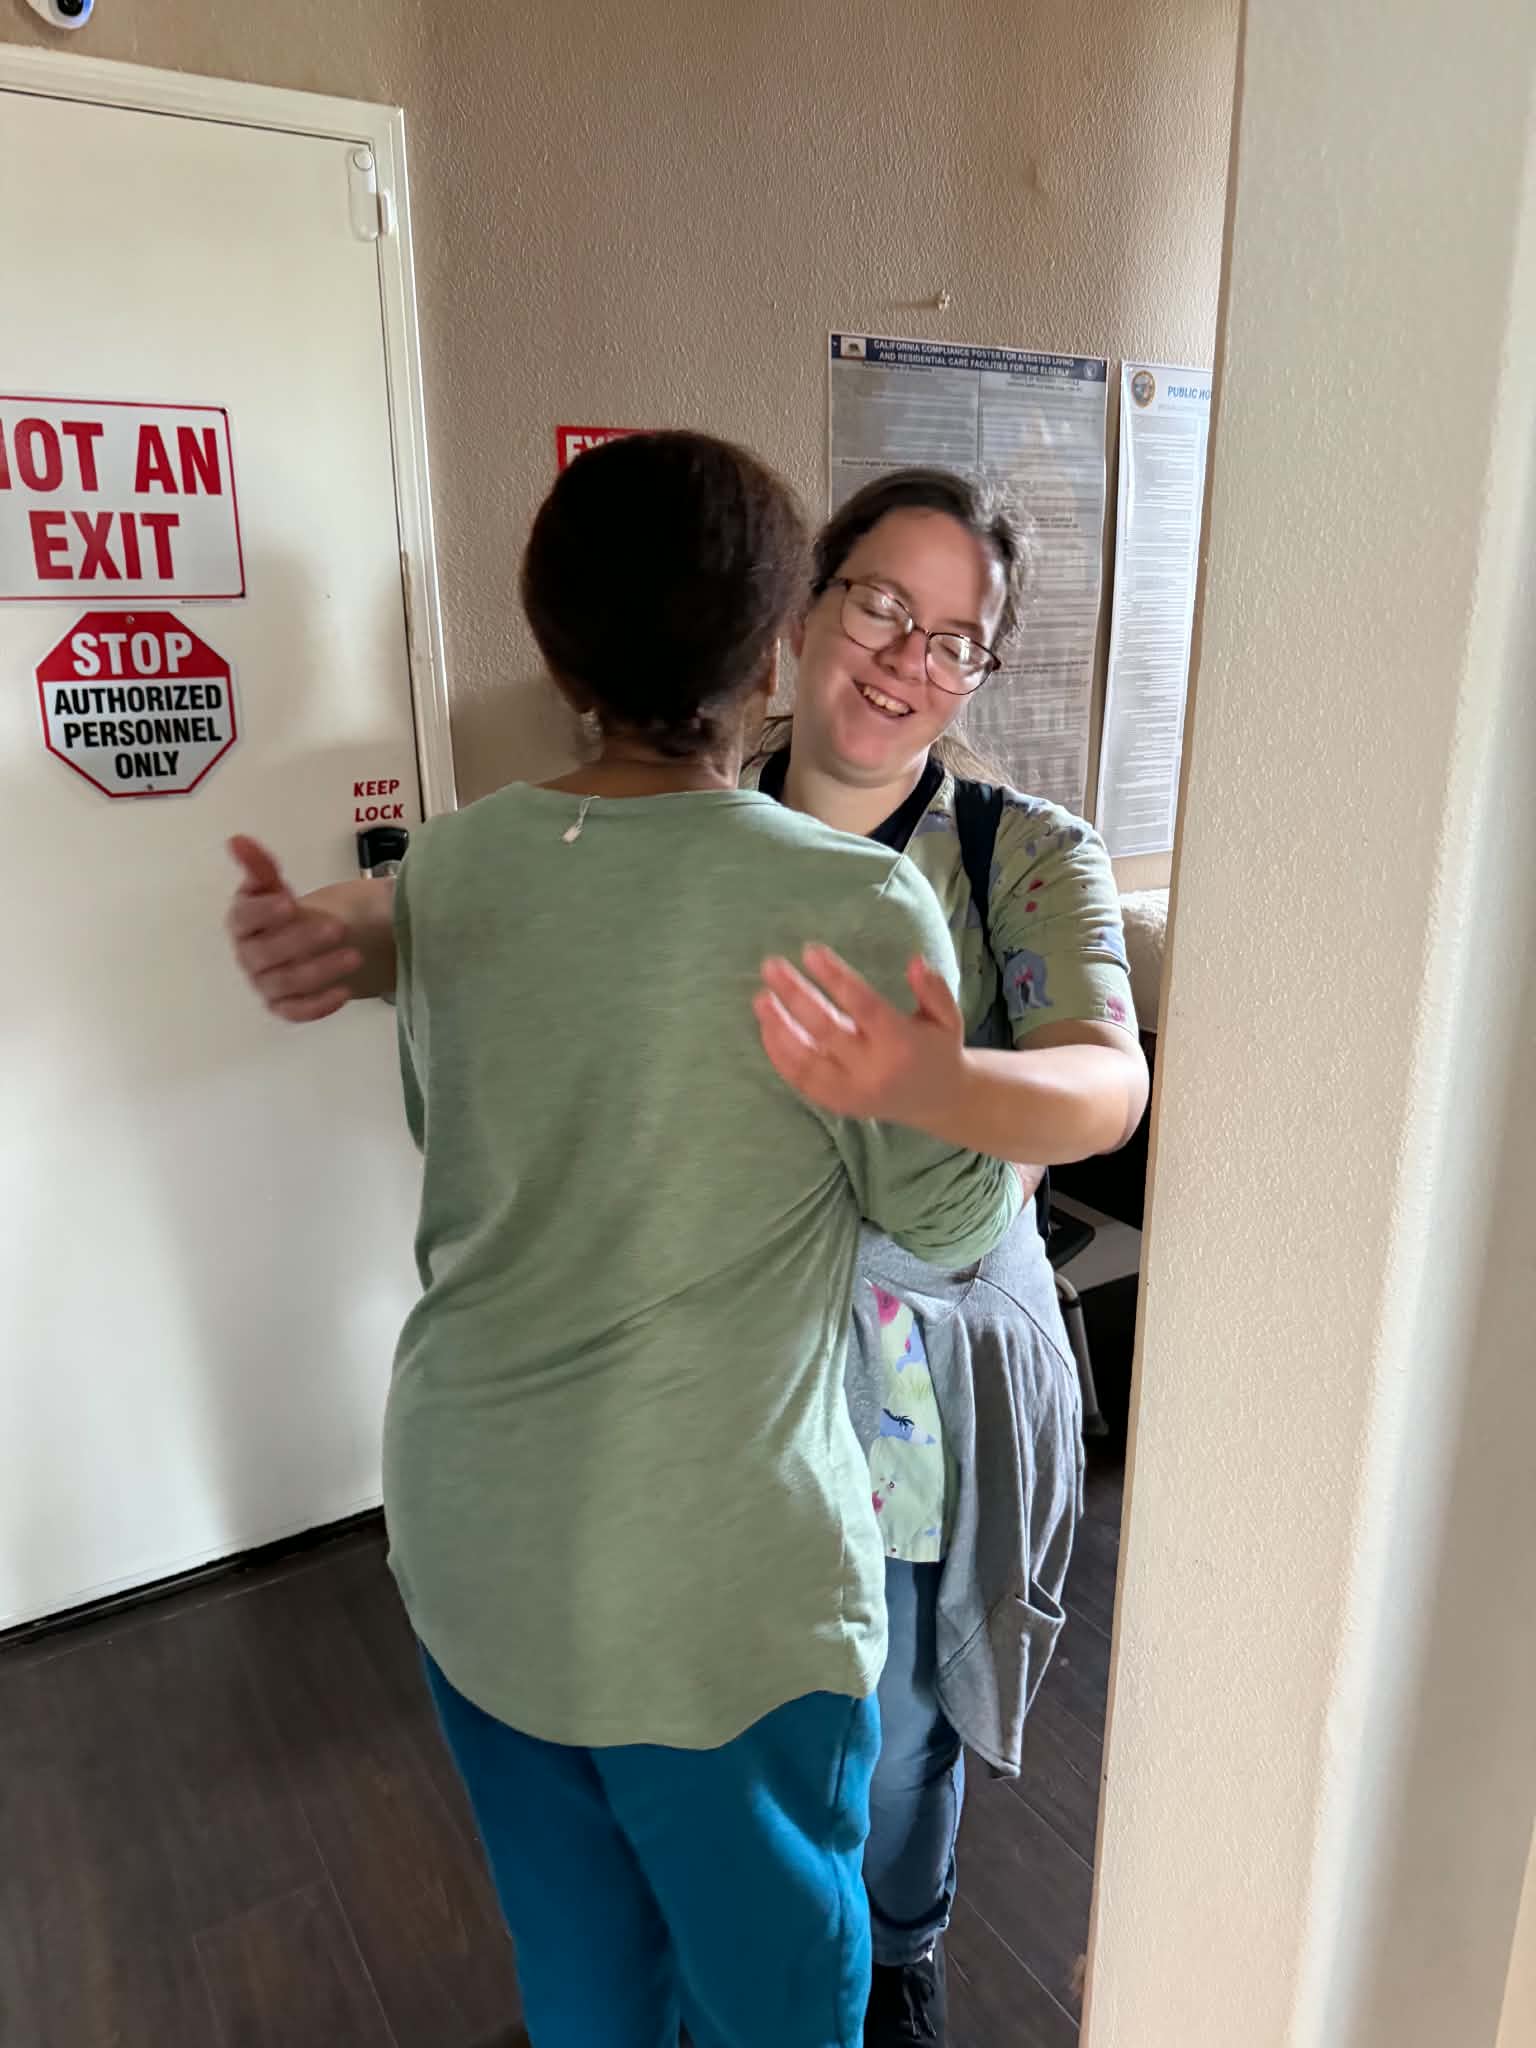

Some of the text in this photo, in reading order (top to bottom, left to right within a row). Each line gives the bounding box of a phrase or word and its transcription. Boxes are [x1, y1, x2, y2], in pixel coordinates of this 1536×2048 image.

[873, 340, 1075, 367] CALIFORNIA COMPLIANCE POSTER FOR ASSISTED LIVING
[879, 351, 1071, 377] AND RESIDENTIAL CARE FACILITIES FOR THE ELDERLY
[1168, 385, 1197, 399] PUBLIC
[134, 424, 222, 496] AN
[28, 510, 180, 580] EXIT
[71, 632, 193, 677] STOP
[54, 684, 222, 716] AUTHORIZED
[62, 717, 222, 749] PERSONNEL
[115, 751, 180, 780] ONLY
[353, 779, 400, 798] KEEP
[354, 803, 405, 823] LOCK
